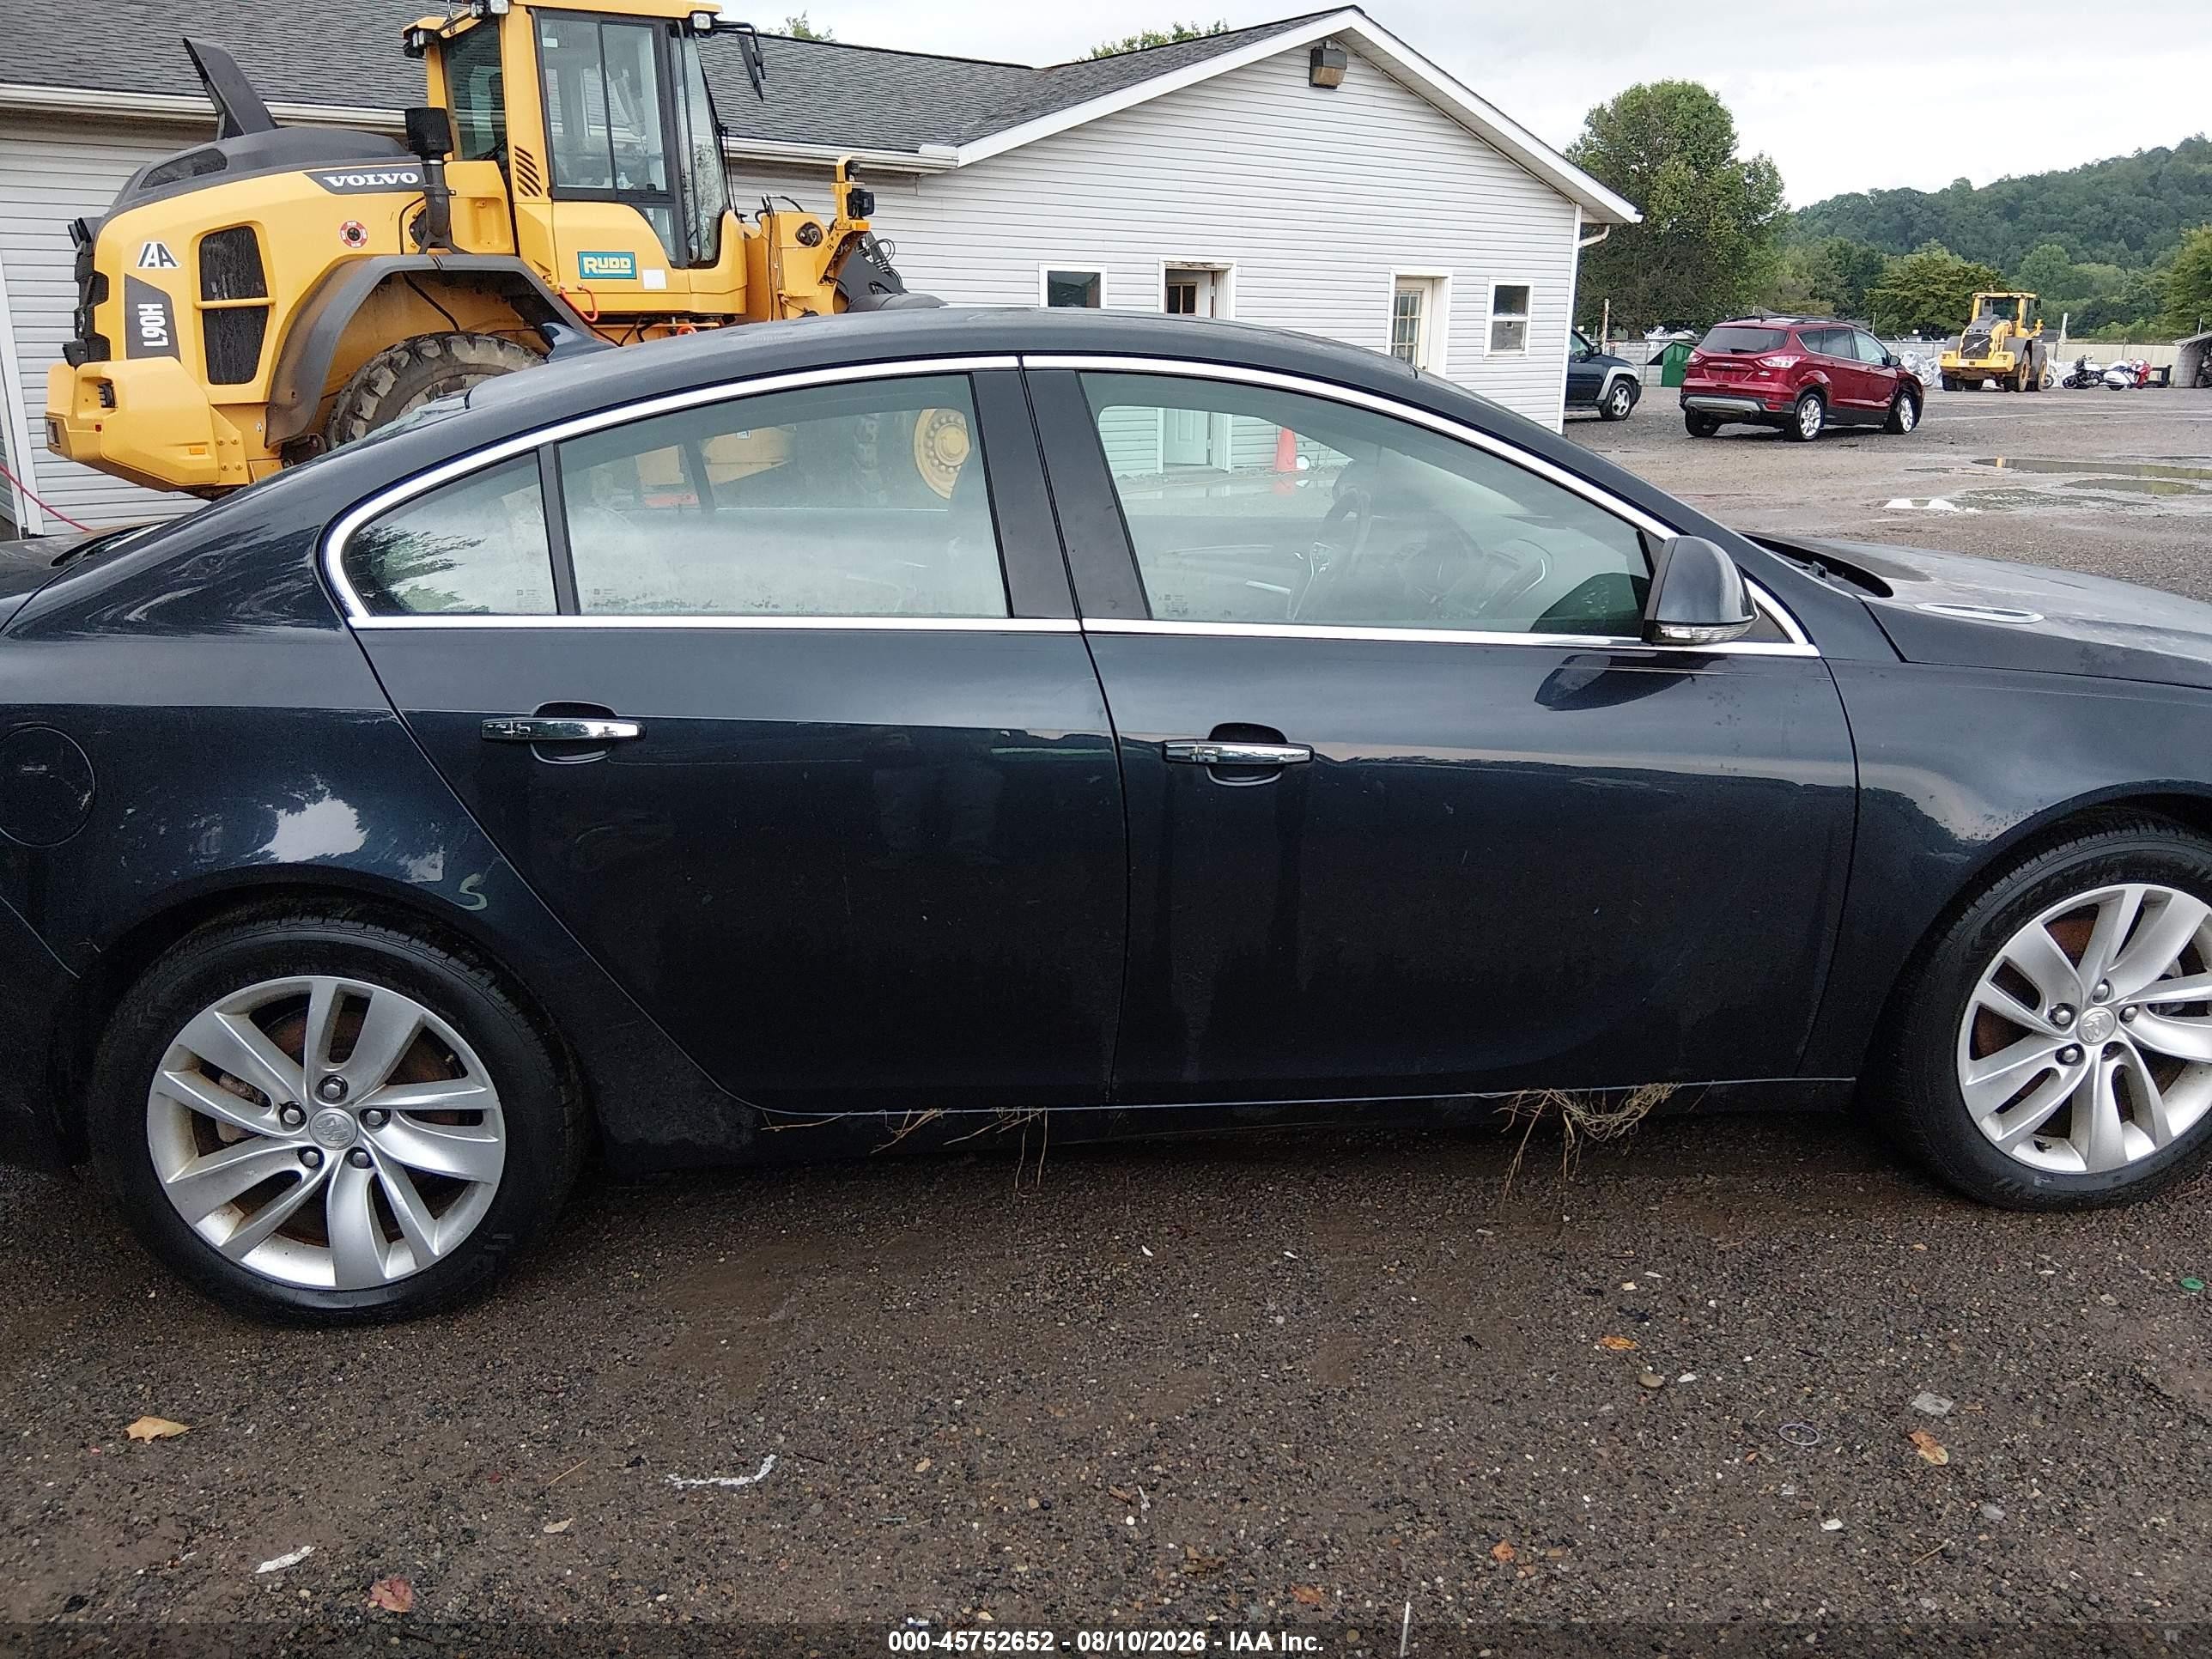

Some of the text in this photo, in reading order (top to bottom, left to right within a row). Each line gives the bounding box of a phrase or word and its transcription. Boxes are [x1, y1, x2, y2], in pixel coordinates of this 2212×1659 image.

[322, 172, 419, 187] VOLVO
[582, 257, 632, 274] RUDD
[137, 303, 169, 347] L90H
